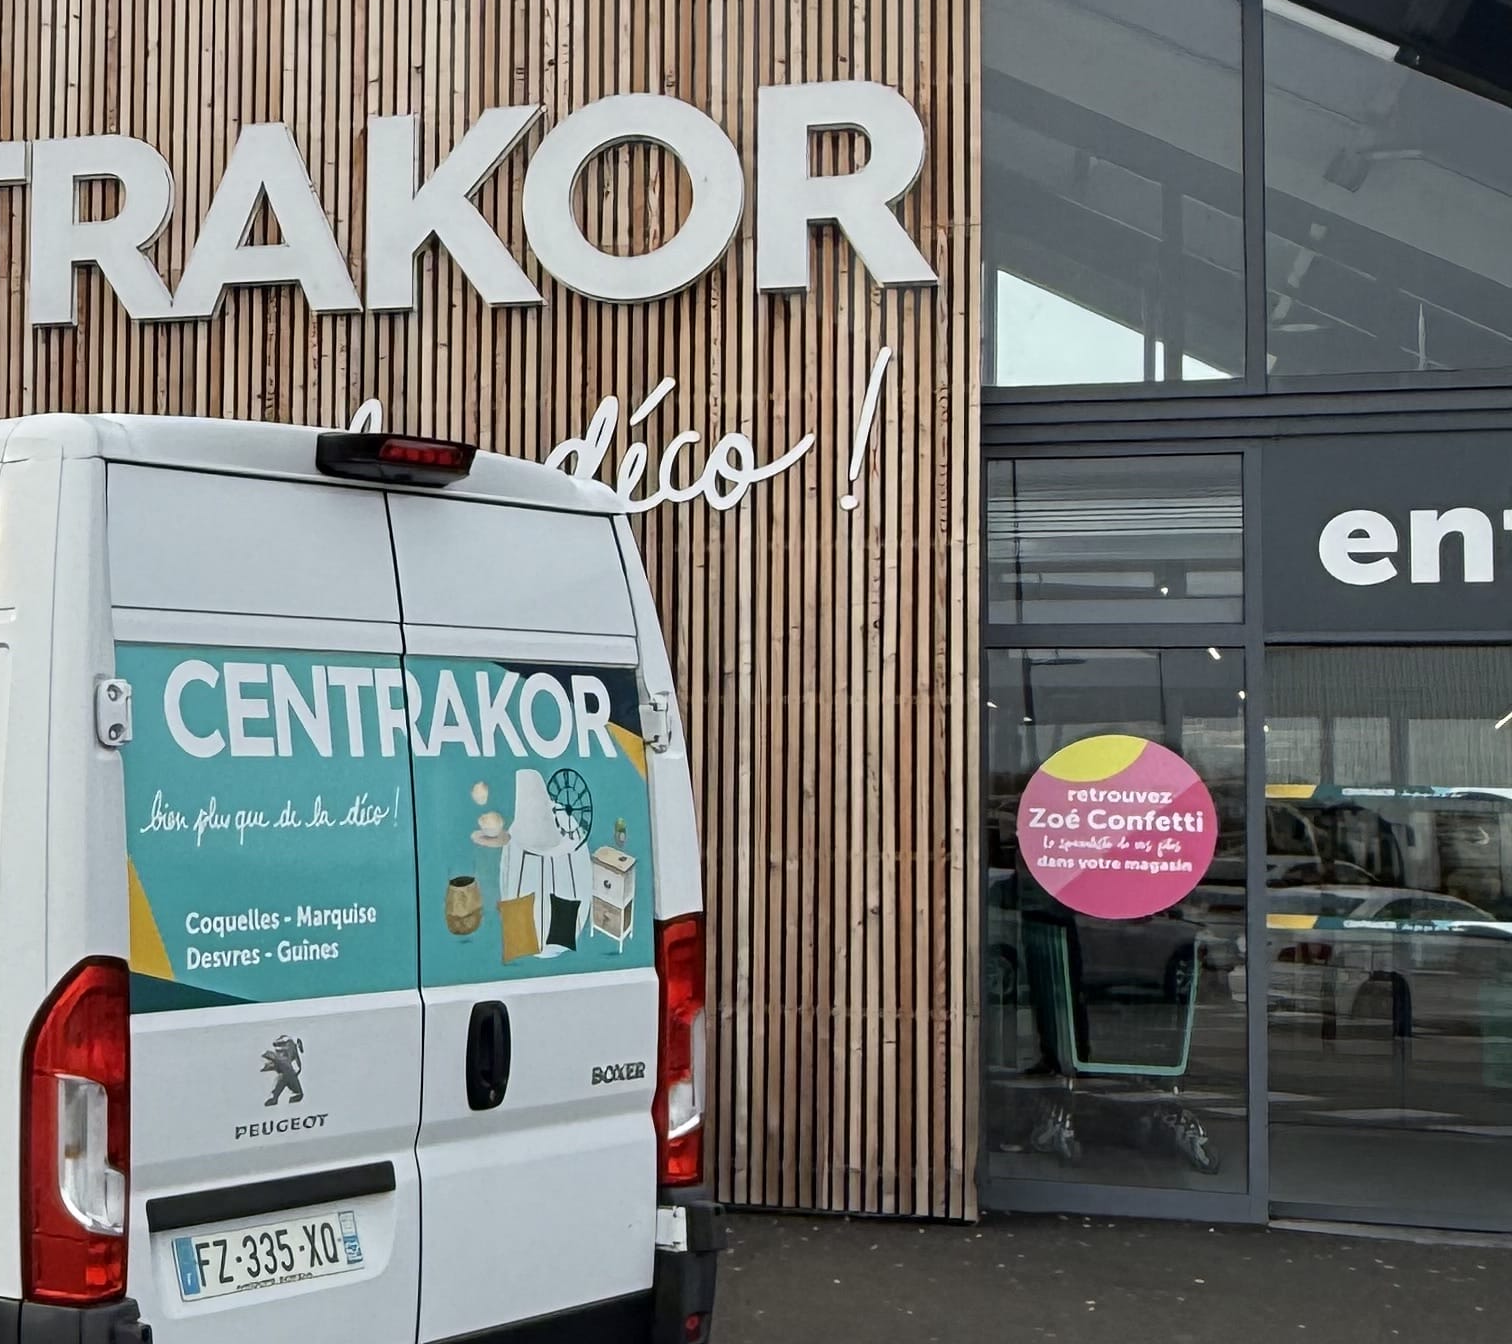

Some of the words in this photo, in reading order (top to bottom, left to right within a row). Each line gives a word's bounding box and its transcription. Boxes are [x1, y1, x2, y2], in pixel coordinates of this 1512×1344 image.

[1318, 507, 1512, 586] en
[164, 659, 619, 759] CENTRAKOR
[1067, 788, 1173, 804] retrouvez
[140, 789, 188, 833] bien
[235, 810, 270, 845] que
[273, 800, 302, 829] de
[305, 794, 337, 828] la
[1028, 807, 1080, 830] Zoé
[1087, 809, 1204, 832] Confetti
[1037, 855, 1074, 870] dans
[1078, 857, 1121, 870] votre
[1124, 859, 1193, 874] magasin
[185, 909, 280, 938] Coquelles
[297, 903, 377, 931] Marquise
[187, 946, 261, 970] Desvres
[277, 939, 339, 962] Guînes
[591, 1061, 646, 1086] BOXER
[234, 1113, 329, 1140] PEUGEOT
